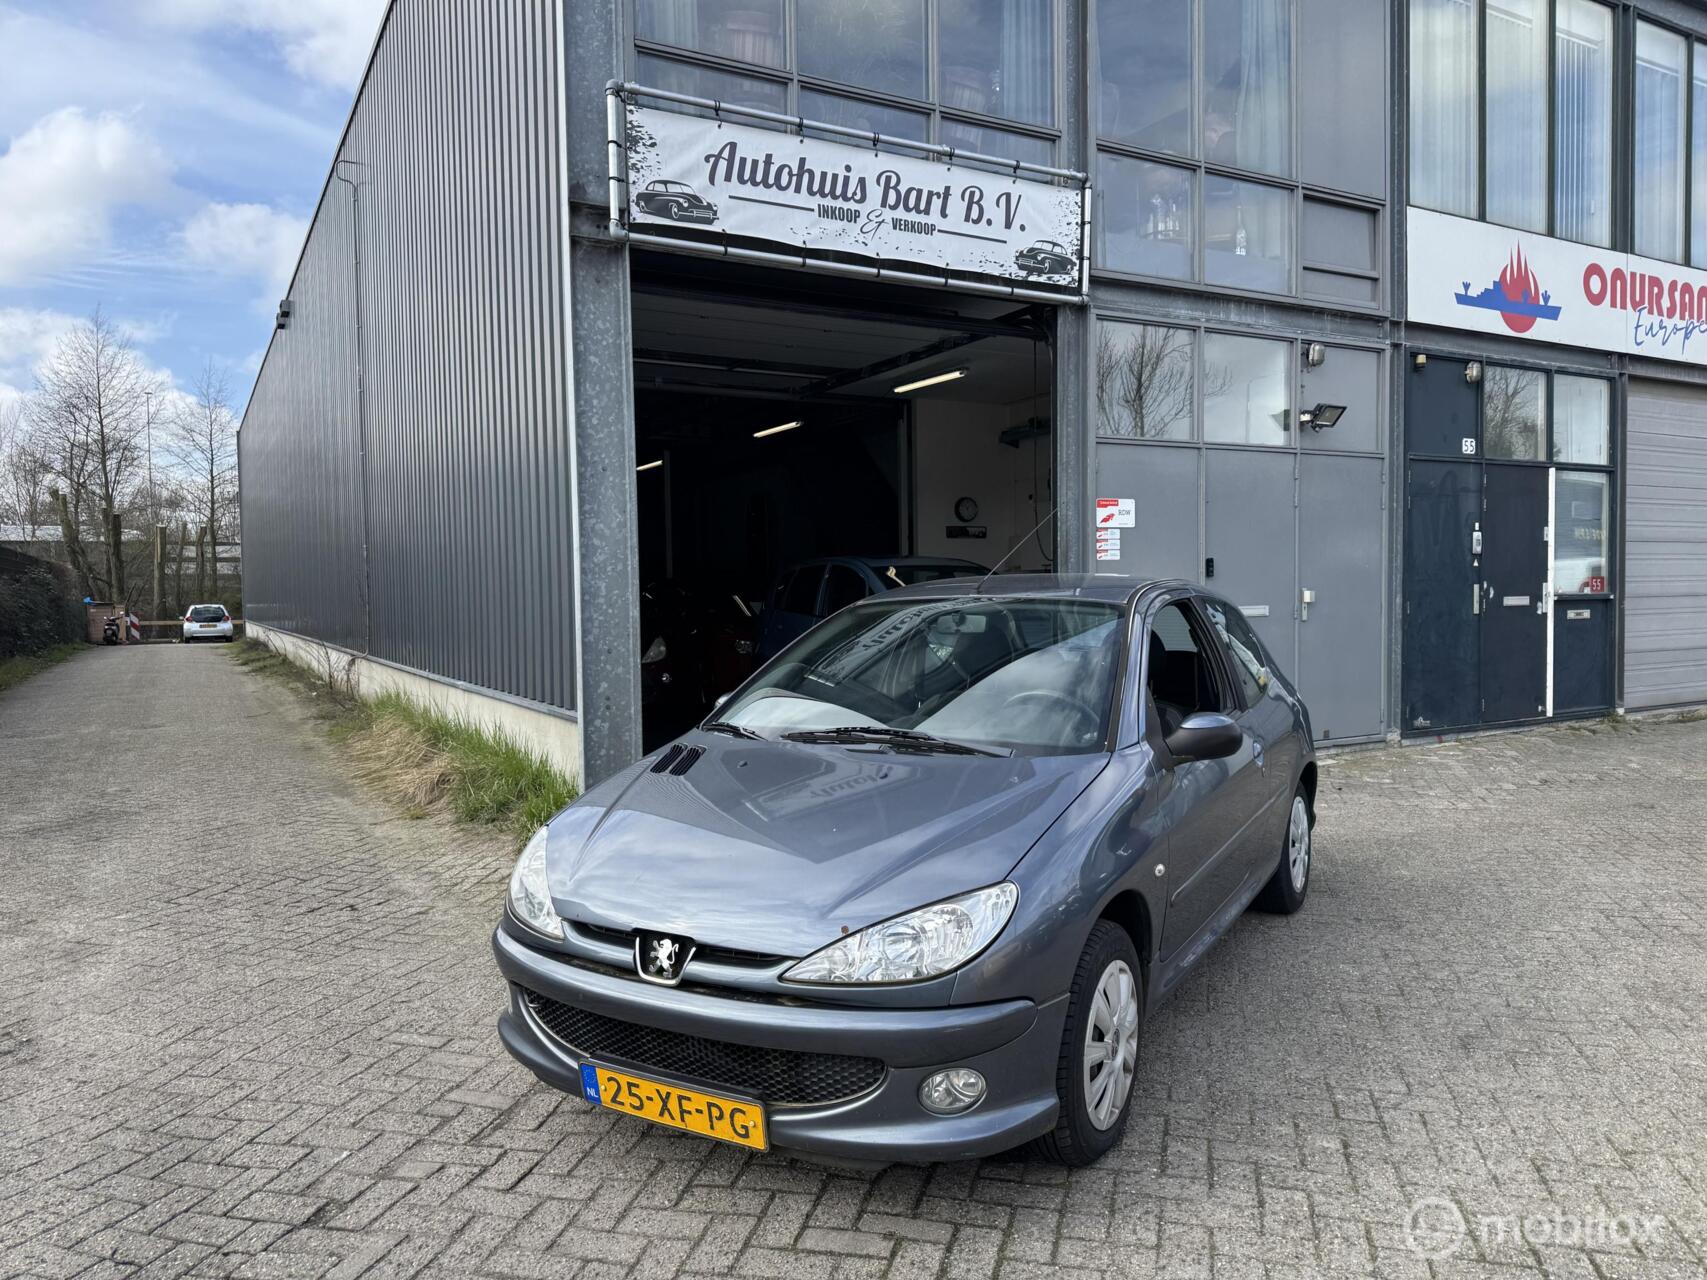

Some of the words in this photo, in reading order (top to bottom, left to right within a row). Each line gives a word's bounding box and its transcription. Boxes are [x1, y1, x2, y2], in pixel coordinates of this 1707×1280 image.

[704, 141, 868, 205] Autohuis
[876, 169, 952, 220] Bart
[961, 185, 1026, 233] B.V.
[817, 203, 861, 224] INKOOP
[891, 217, 937, 236] VERKOOP
[1634, 306, 1707, 355] Europe
[1464, 440, 1475, 453] 55
[1592, 578, 1601, 591] 55
[586, 1086, 599, 1099] NL
[606, 1076, 750, 1139] 25-XF-PG
